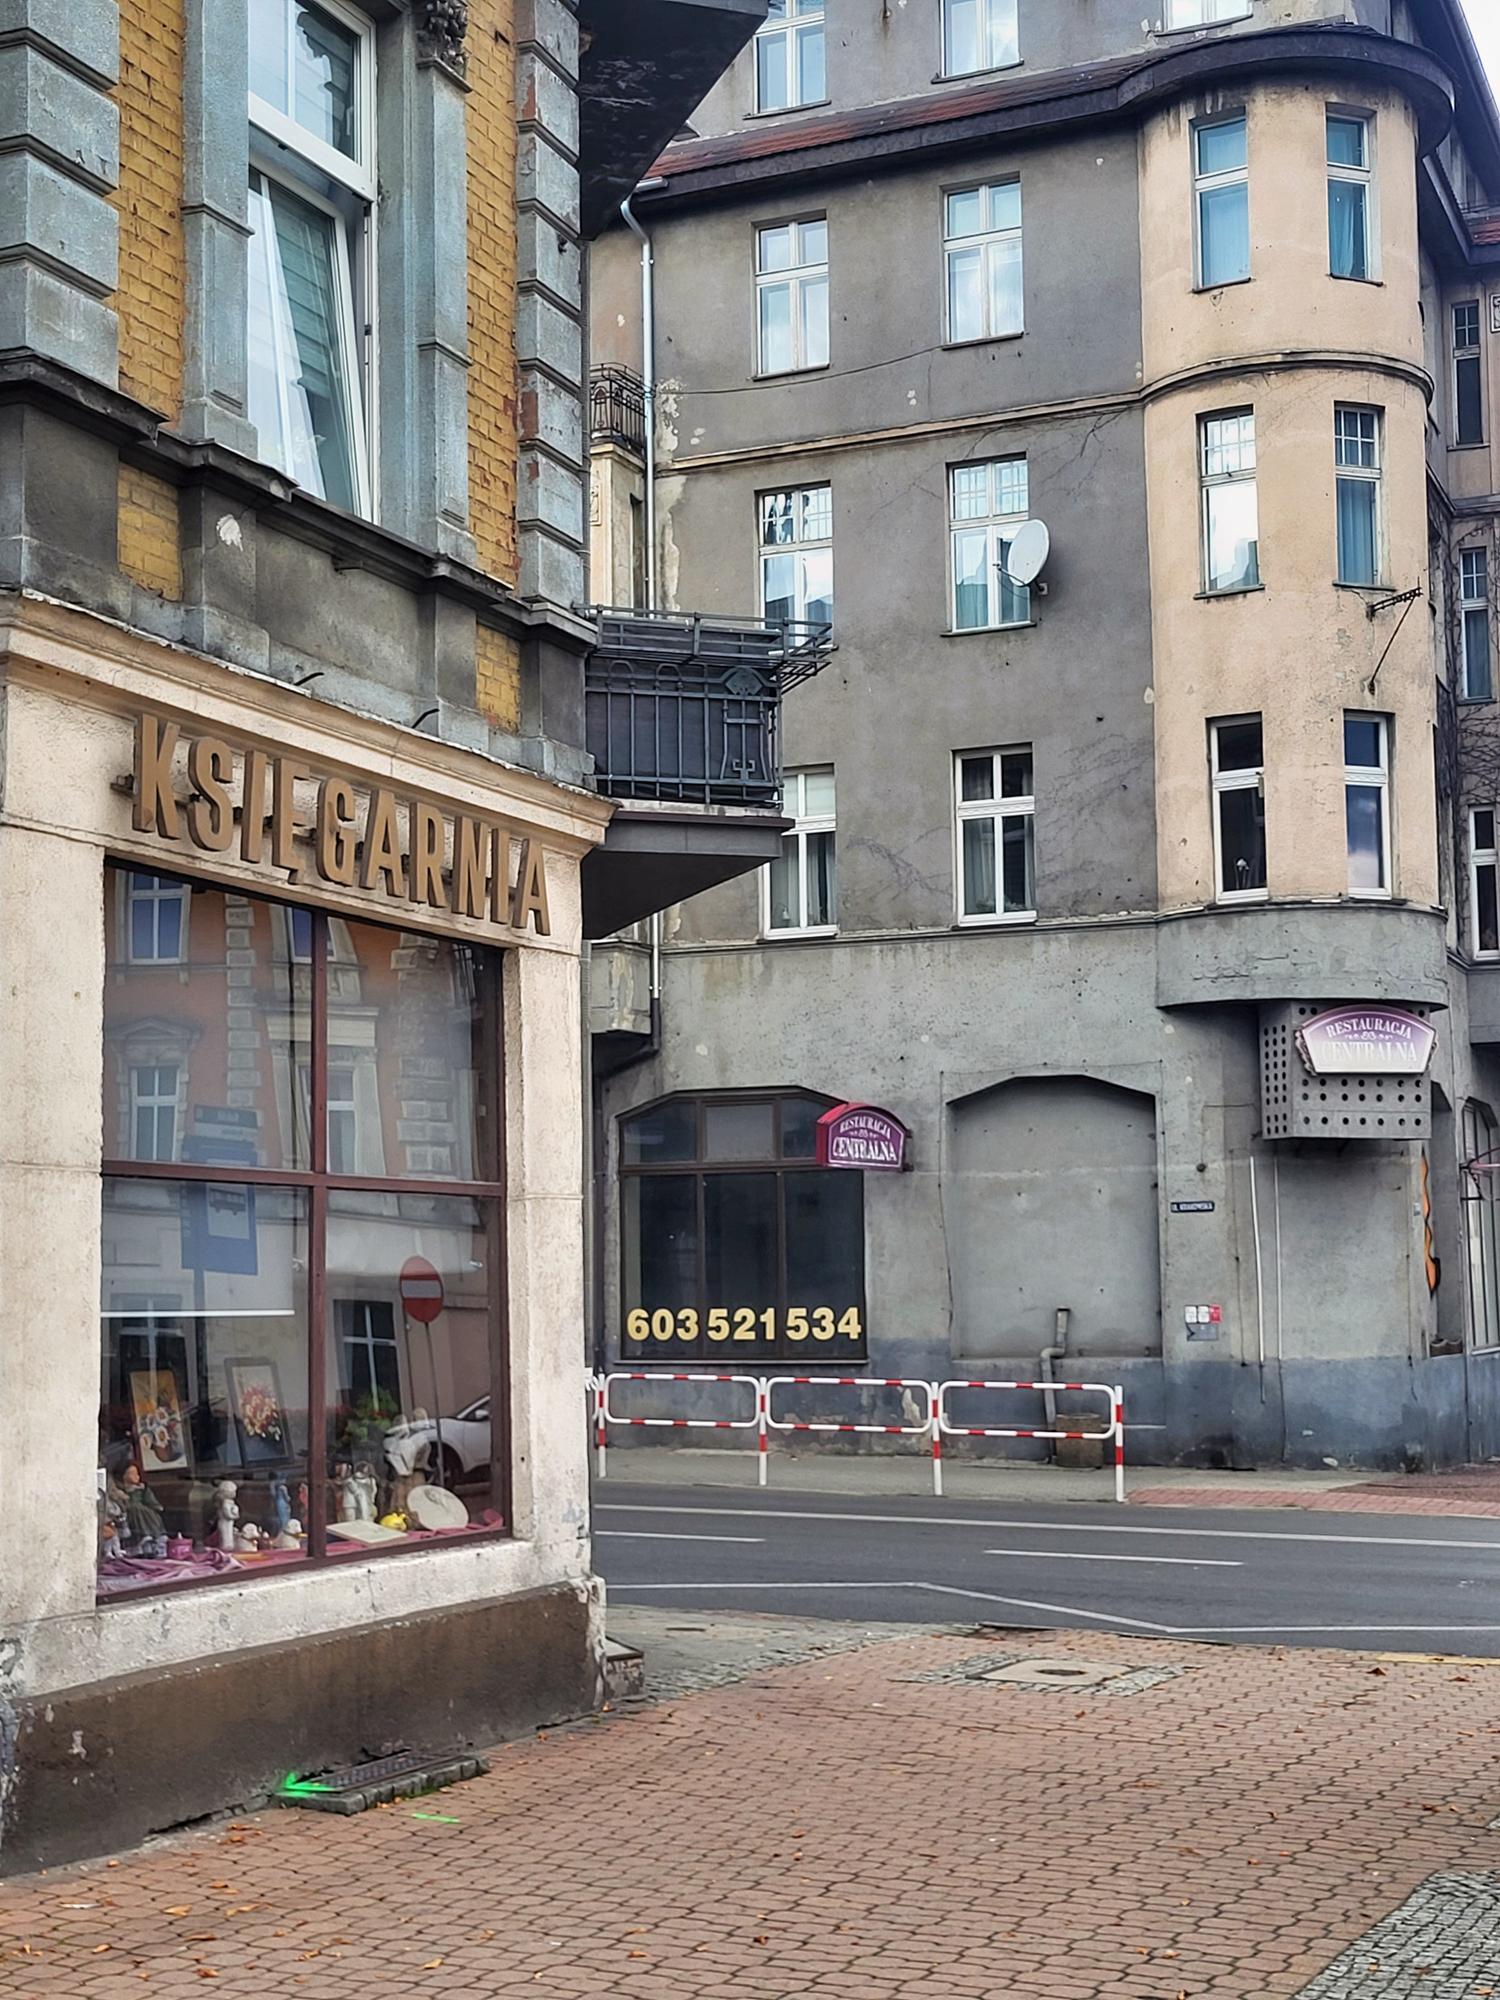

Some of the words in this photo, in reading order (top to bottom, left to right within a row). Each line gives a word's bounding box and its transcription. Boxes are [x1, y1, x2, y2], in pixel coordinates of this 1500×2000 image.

[132, 713, 551, 937] KSIĘGARNIA
[1325, 1017, 1412, 1040] RESTAURACJA
[1320, 1041, 1417, 1062] CENTRALNA
[839, 1115, 891, 1140] RESTAURACJA
[832, 1136, 898, 1162] CENTRALNA
[626, 1307, 700, 1341] 603
[706, 1307, 776, 1341] 521
[785, 1306, 863, 1341] 534
